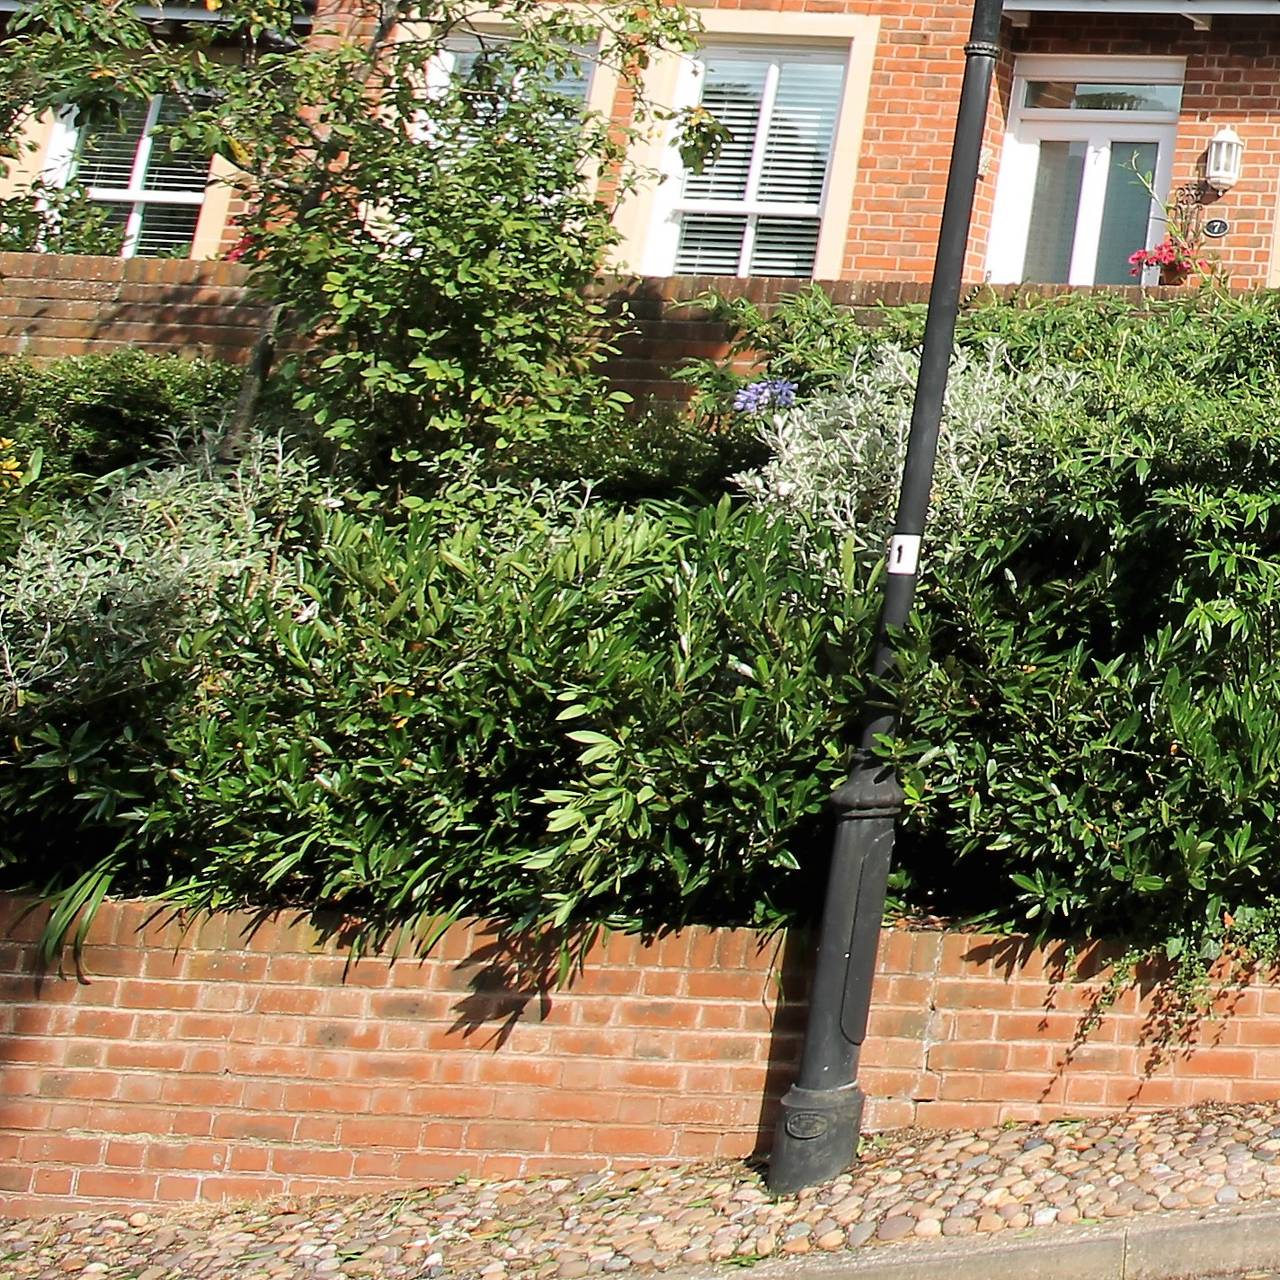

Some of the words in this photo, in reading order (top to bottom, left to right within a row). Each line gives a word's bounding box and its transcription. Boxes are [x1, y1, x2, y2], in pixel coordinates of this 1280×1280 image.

[1091, 150, 1101, 166] 7
[1213, 221, 1221, 233] 7
[897, 544, 903, 564] 1
